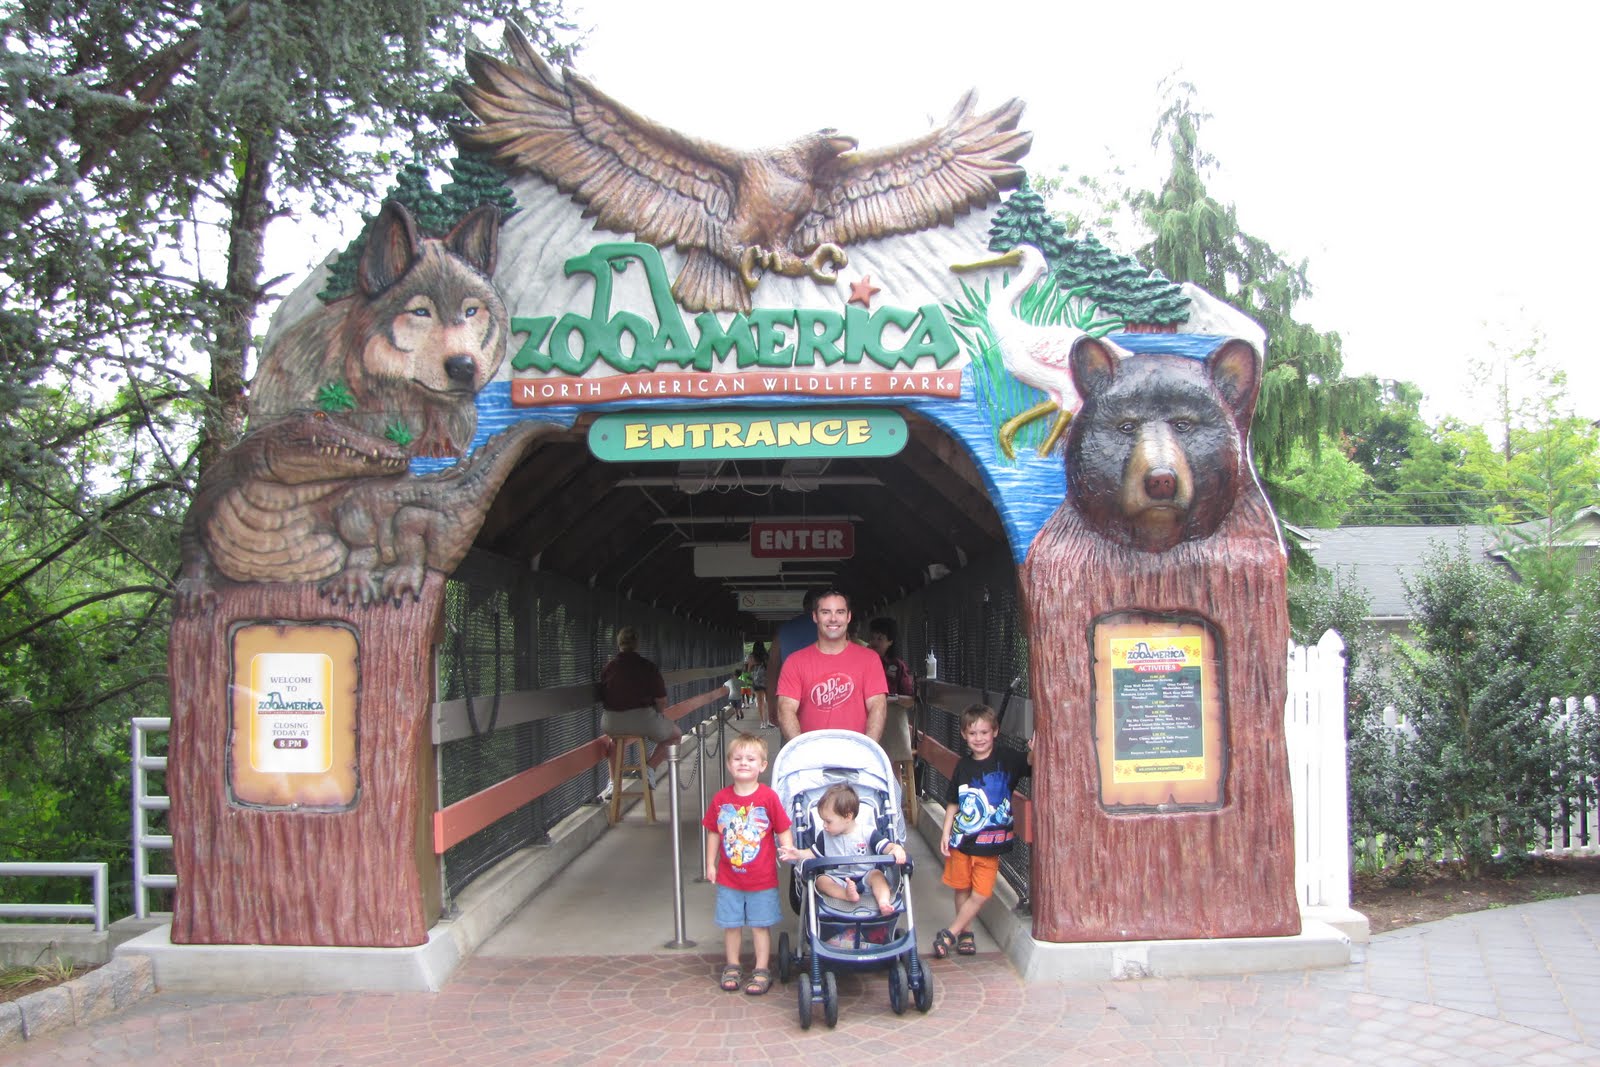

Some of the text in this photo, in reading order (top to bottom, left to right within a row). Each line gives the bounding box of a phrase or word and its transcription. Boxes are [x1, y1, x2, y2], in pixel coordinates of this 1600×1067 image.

[511, 243, 960, 373] ZOOAMERICA
[523, 384, 601, 398] NORTH
[620, 377, 745, 395] AMERICAN
[762, 376, 873, 390] WILDLIFE
[624, 418, 872, 450] ENTRANCE
[760, 529, 844, 550] ENTER
[1127, 642, 1185, 659] ZOOAMERICA
[1138, 664, 1176, 672] ACTIVITIES
[816, 682, 851, 707] Pepper
[827, 677, 841, 692] Dr
[258, 691, 323, 709] ZOOAMERICA
